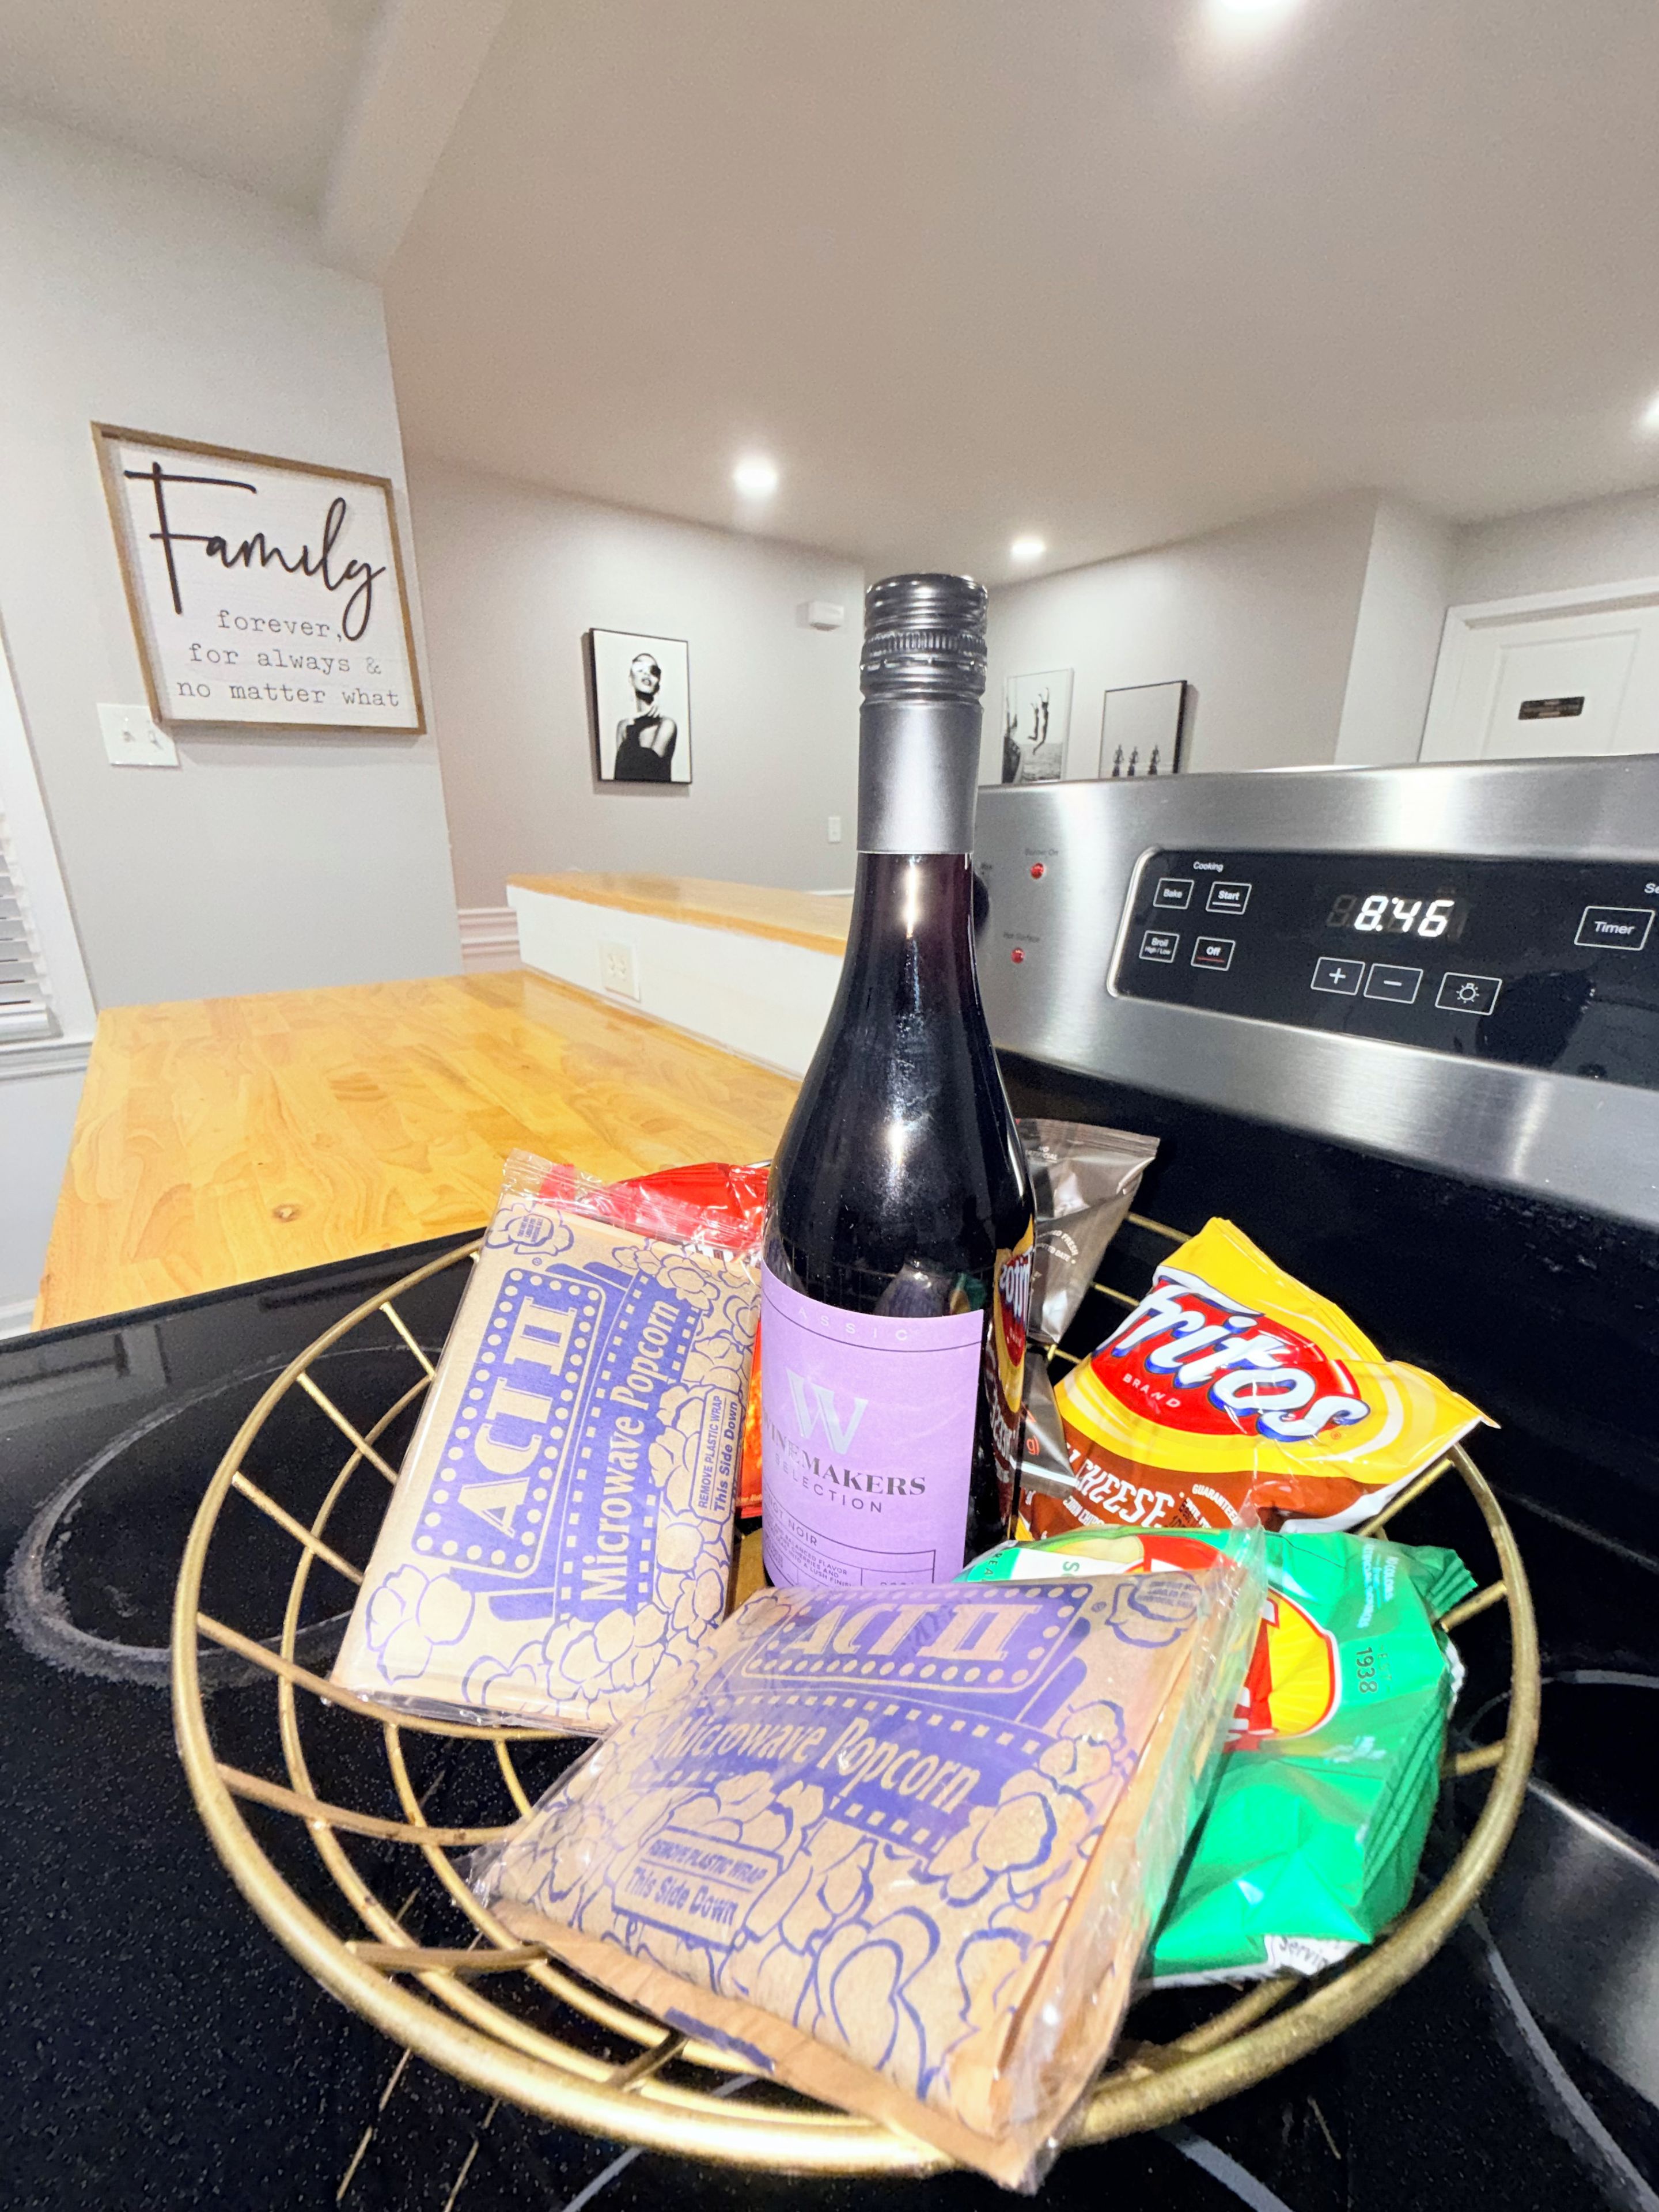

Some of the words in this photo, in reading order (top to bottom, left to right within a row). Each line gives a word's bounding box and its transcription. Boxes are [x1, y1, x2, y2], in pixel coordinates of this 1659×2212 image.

[123, 461, 387, 642] Family
[217, 609, 342, 643] forever,
[189, 643, 239, 665] for
[257, 649, 351, 676] always
[366, 657, 382, 675] &
[177, 681, 211, 699] no
[230, 683, 326, 704] matter
[342, 686, 400, 708] what
[1193, 861, 1224, 873] Cooking
[1163, 888, 1183, 899] Bake
[1218, 890, 1240, 901] Start
[1152, 937, 1169, 948] Broil
[1594, 921, 1636, 935] Timer
[1206, 945, 1221, 957] Off
[504, 1296, 577, 1377] II
[1092, 1264, 1372, 1444] Fritos
[609, 1300, 680, 1414] Popcorn
[1123, 1373, 1181, 1408] BRAND
[710, 1395, 722, 1423] WRAP
[724, 1401, 738, 1441] Down
[786, 1368, 869, 1455] W
[458, 1377, 554, 1539] ACT
[704, 1423, 719, 1464] PLASTIC
[719, 1444, 733, 1476] Side
[698, 1465, 713, 1509] REMOVE
[714, 1479, 729, 1512] This
[775, 1453, 882, 1513] SELECTION
[581, 1415, 646, 1603] Microwave
[788, 1519, 818, 1547] NOIR
[819, 1559, 848, 1575] FLAVOR
[823, 1568, 839, 1578] AND
[781, 1603, 941, 1656] ACT
[1356, 1646, 1378, 1694] 1938
[653, 1715, 827, 1763] Microwave
[817, 1717, 980, 1816] Popcorn
[624, 1866, 657, 1899] This
[654, 1876, 691, 1910] Side
[688, 1884, 738, 1926] Down
